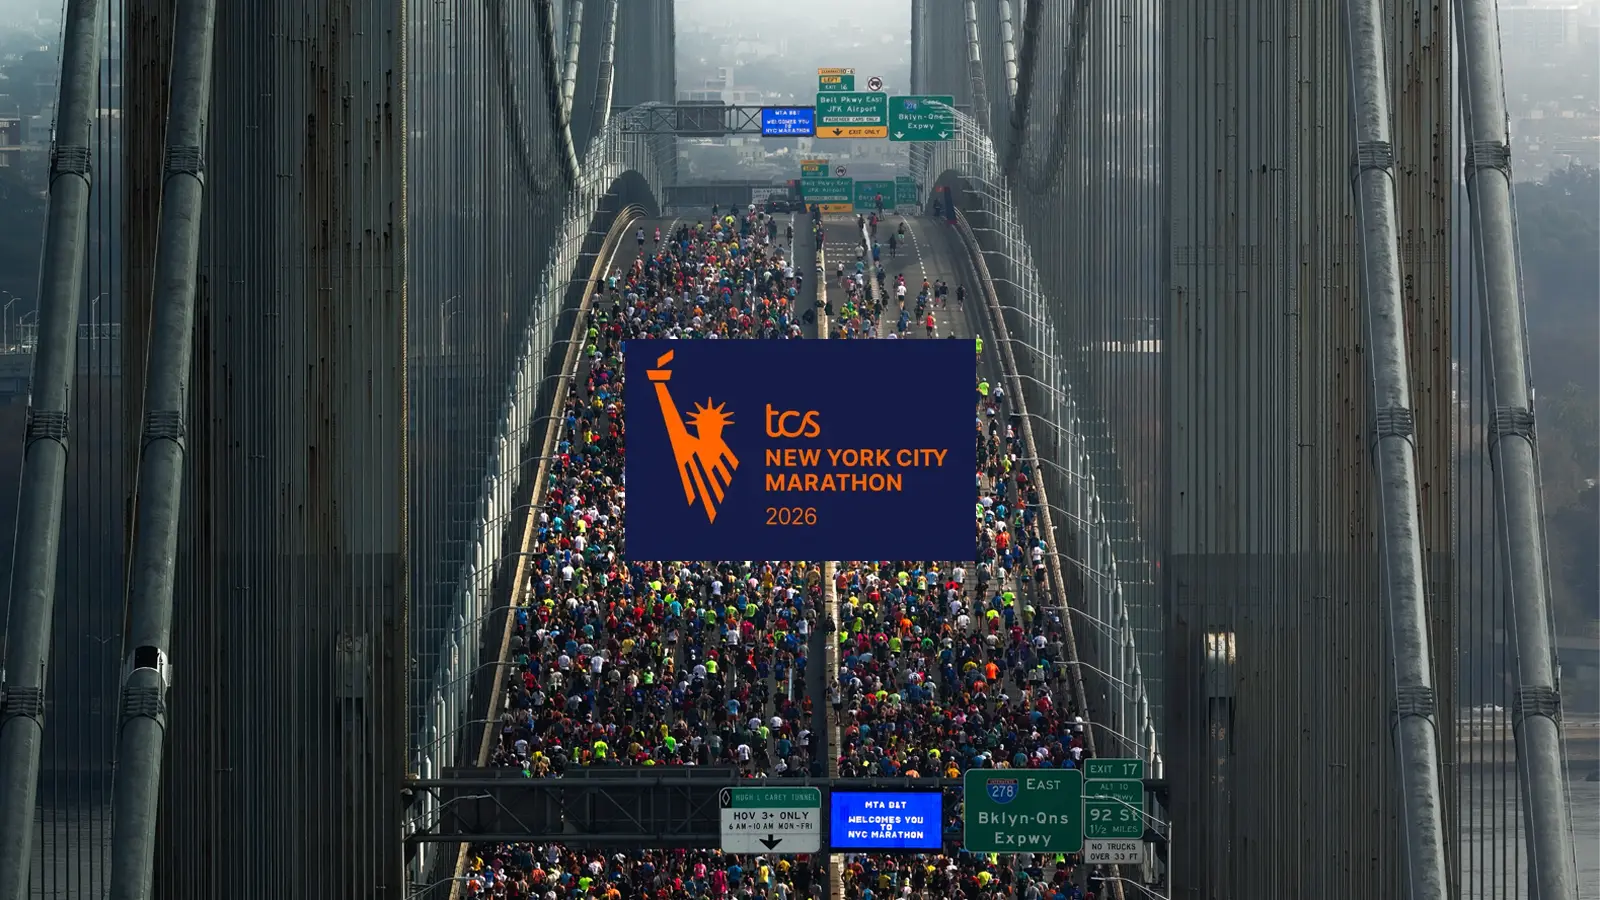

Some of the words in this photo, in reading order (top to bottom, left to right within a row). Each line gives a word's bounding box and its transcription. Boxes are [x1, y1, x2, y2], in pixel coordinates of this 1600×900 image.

[1090, 765, 1113, 773] EXIT
[1122, 763, 1137, 775] 17
[1027, 778, 1061, 790] EAST
[992, 786, 1014, 797] 278
[734, 812, 756, 820] HOV
[762, 812, 774, 820] 3+
[780, 812, 809, 820] ONLY
[979, 812, 1069, 827] Bklyn-Qns
[1090, 809, 1112, 821] 92
[1120, 809, 1138, 821] St
[995, 832, 1051, 847] Expwy
